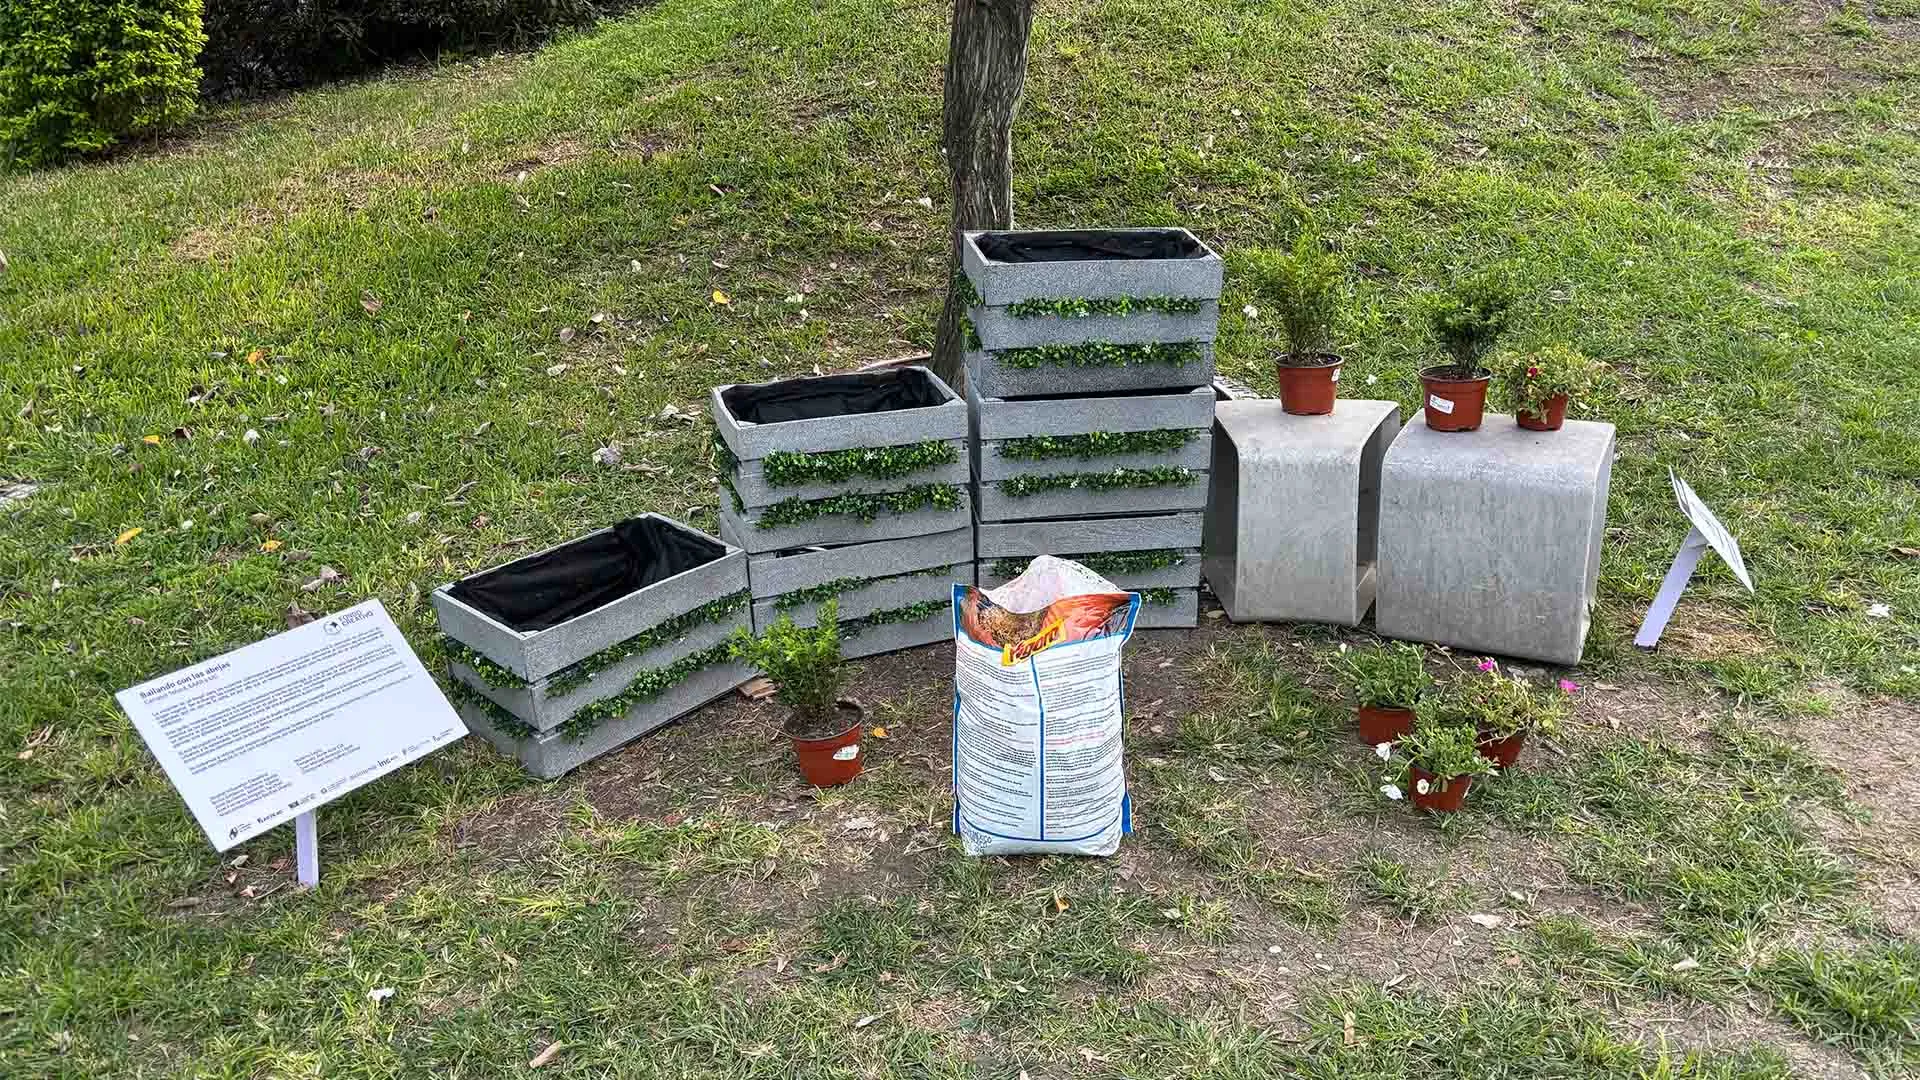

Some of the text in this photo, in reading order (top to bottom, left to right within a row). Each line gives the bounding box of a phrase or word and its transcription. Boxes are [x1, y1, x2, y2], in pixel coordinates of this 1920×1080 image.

[342, 611, 374, 626] CREATIVO
[139, 662, 231, 698] Bailando con las abejas
